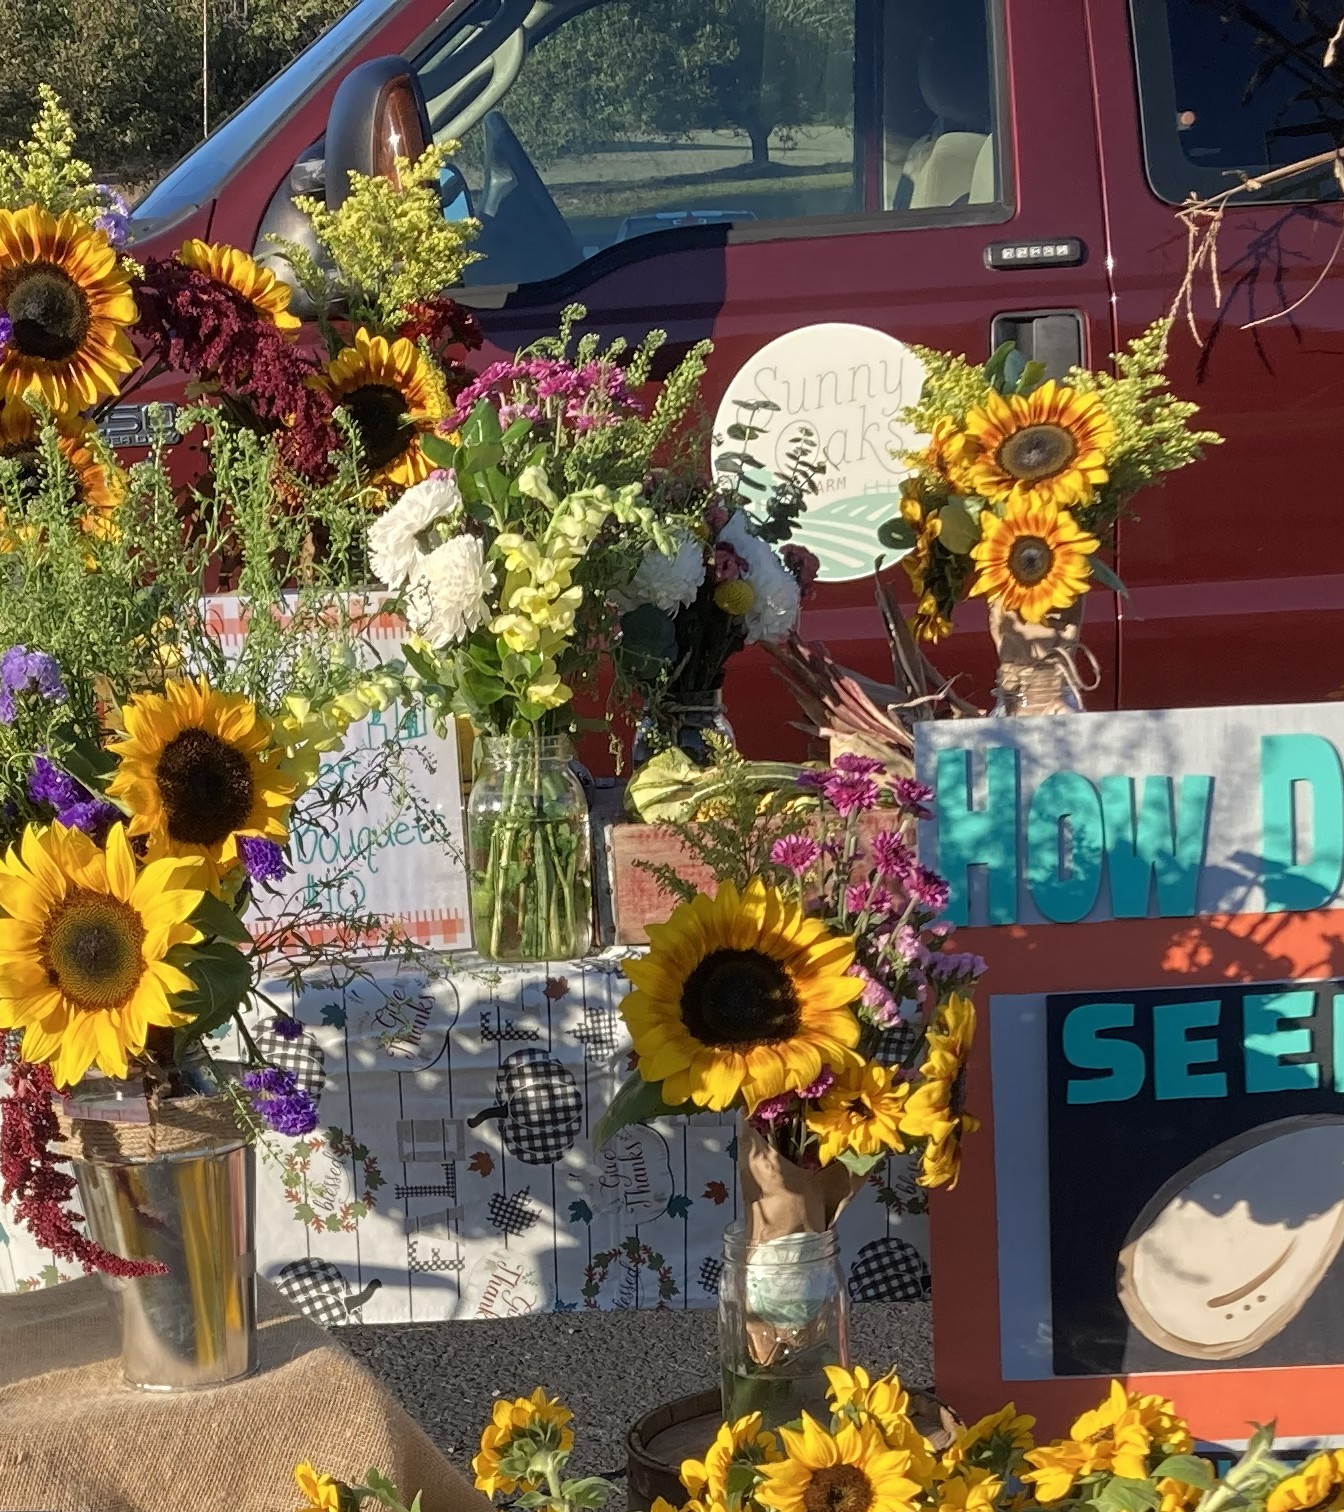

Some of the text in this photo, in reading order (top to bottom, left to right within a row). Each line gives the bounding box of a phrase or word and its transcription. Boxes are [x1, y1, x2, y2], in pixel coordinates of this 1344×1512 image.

[735, 356, 905, 430] Sunny
[774, 404, 918, 475] Oaks
[935, 745, 1215, 927] How
[617, 1140, 653, 1214] Thanks
[474, 1261, 525, 1319] Thank
[611, 1259, 645, 1311] lessed
